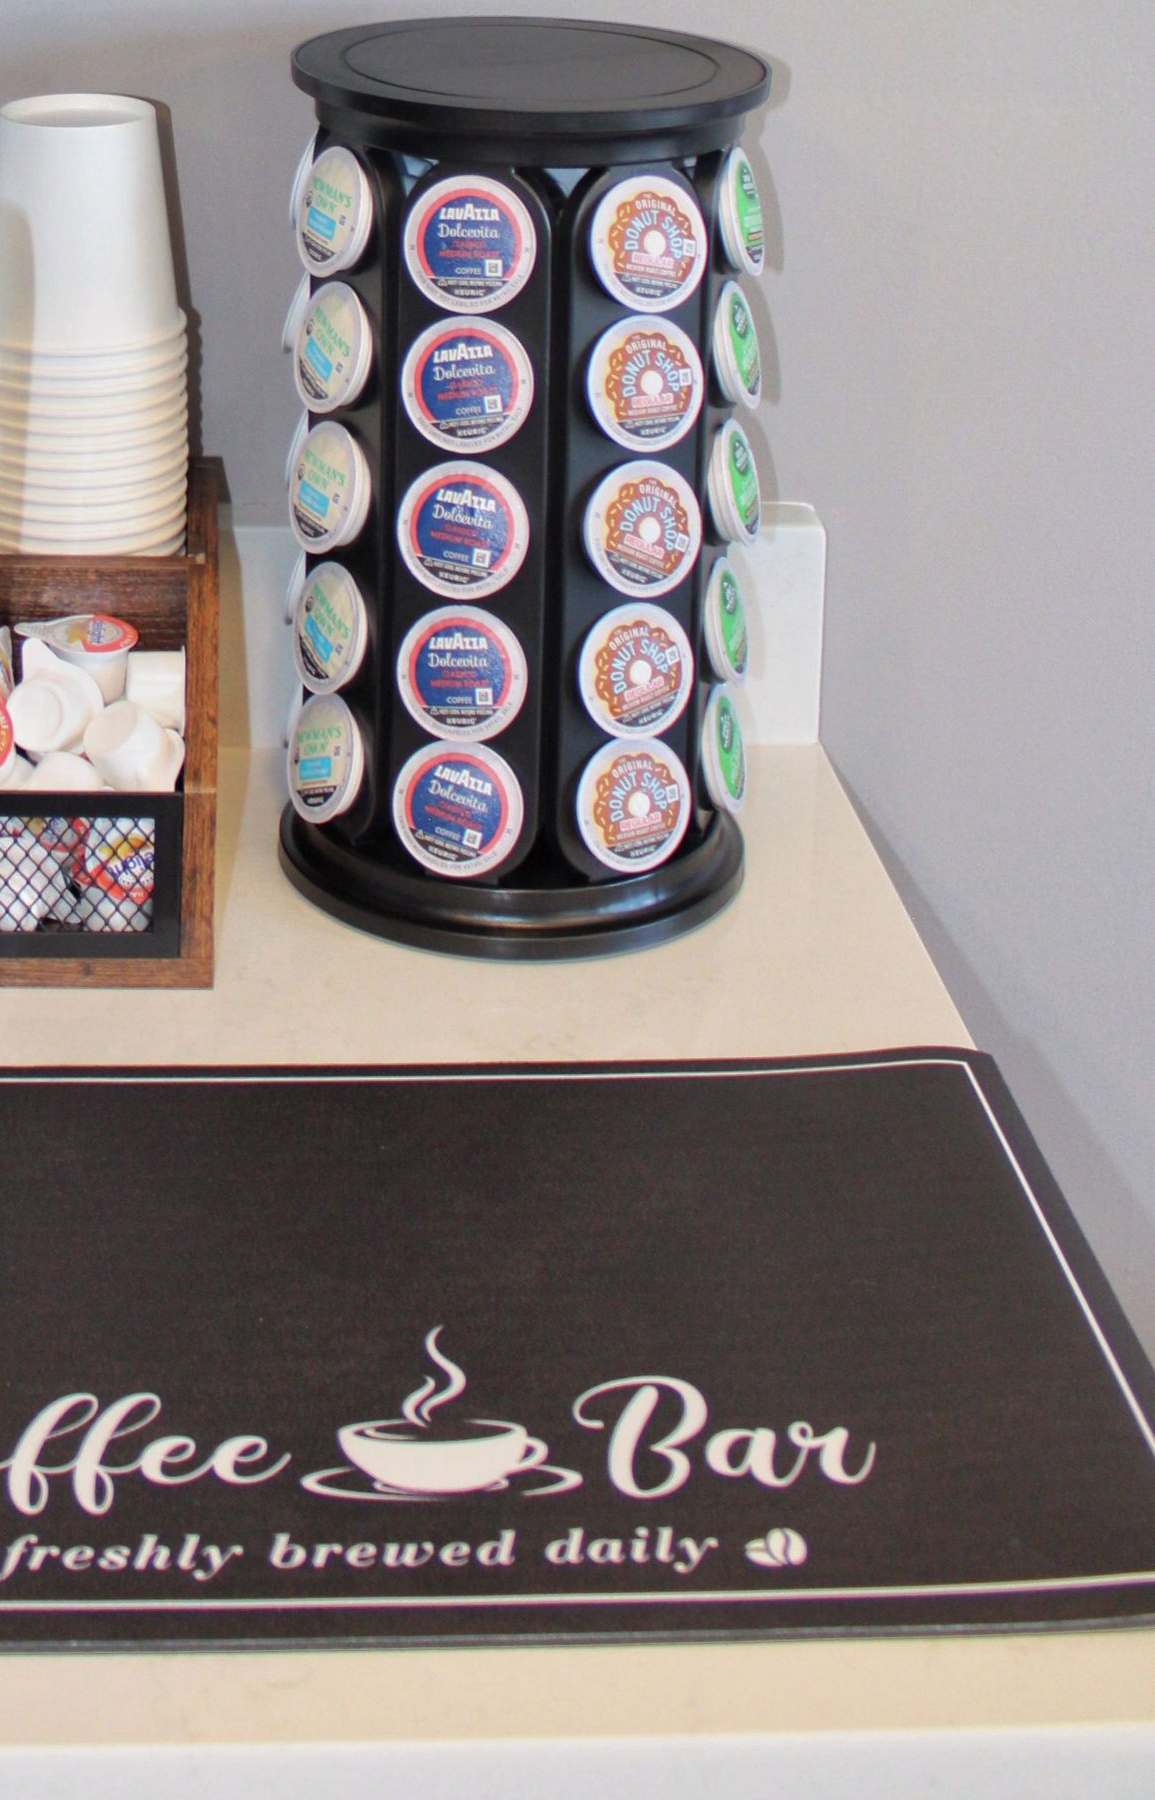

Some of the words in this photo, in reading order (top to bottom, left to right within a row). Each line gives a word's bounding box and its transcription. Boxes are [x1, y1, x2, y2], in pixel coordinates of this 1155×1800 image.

[439, 203, 500, 221] LAVAZZA
[635, 199, 677, 216] ORIGINAL
[437, 223, 500, 239] Dolcevita
[624, 209, 659, 251] DONUT
[661, 215, 683, 259] SHOP
[433, 343, 493, 364] LAVAZZA
[626, 339, 668, 354] ORIGINAL
[621, 349, 651, 397] DONUT
[654, 352, 680, 392] SHOP
[436, 488, 496, 513] LAVAZZA
[639, 484, 677, 509] ORIGINAL
[619, 495, 661, 532] DONUT
[660, 506, 677, 551] SHOP
[429, 632, 488, 650] LAVAZZA
[609, 626, 650, 650] ORIGINAL
[610, 640, 637, 694] DONUT
[639, 638, 669, 673] SHOP
[434, 764, 492, 796] LAVAZZA
[612, 759, 654, 778] ORIGINAL
[609, 771, 637, 822] DONUT
[640, 772, 667, 809] SHOP
[573, 1374, 877, 1499] Bar
[269, 1529, 517, 1570] brewed
[545, 1526, 719, 1574] daily
